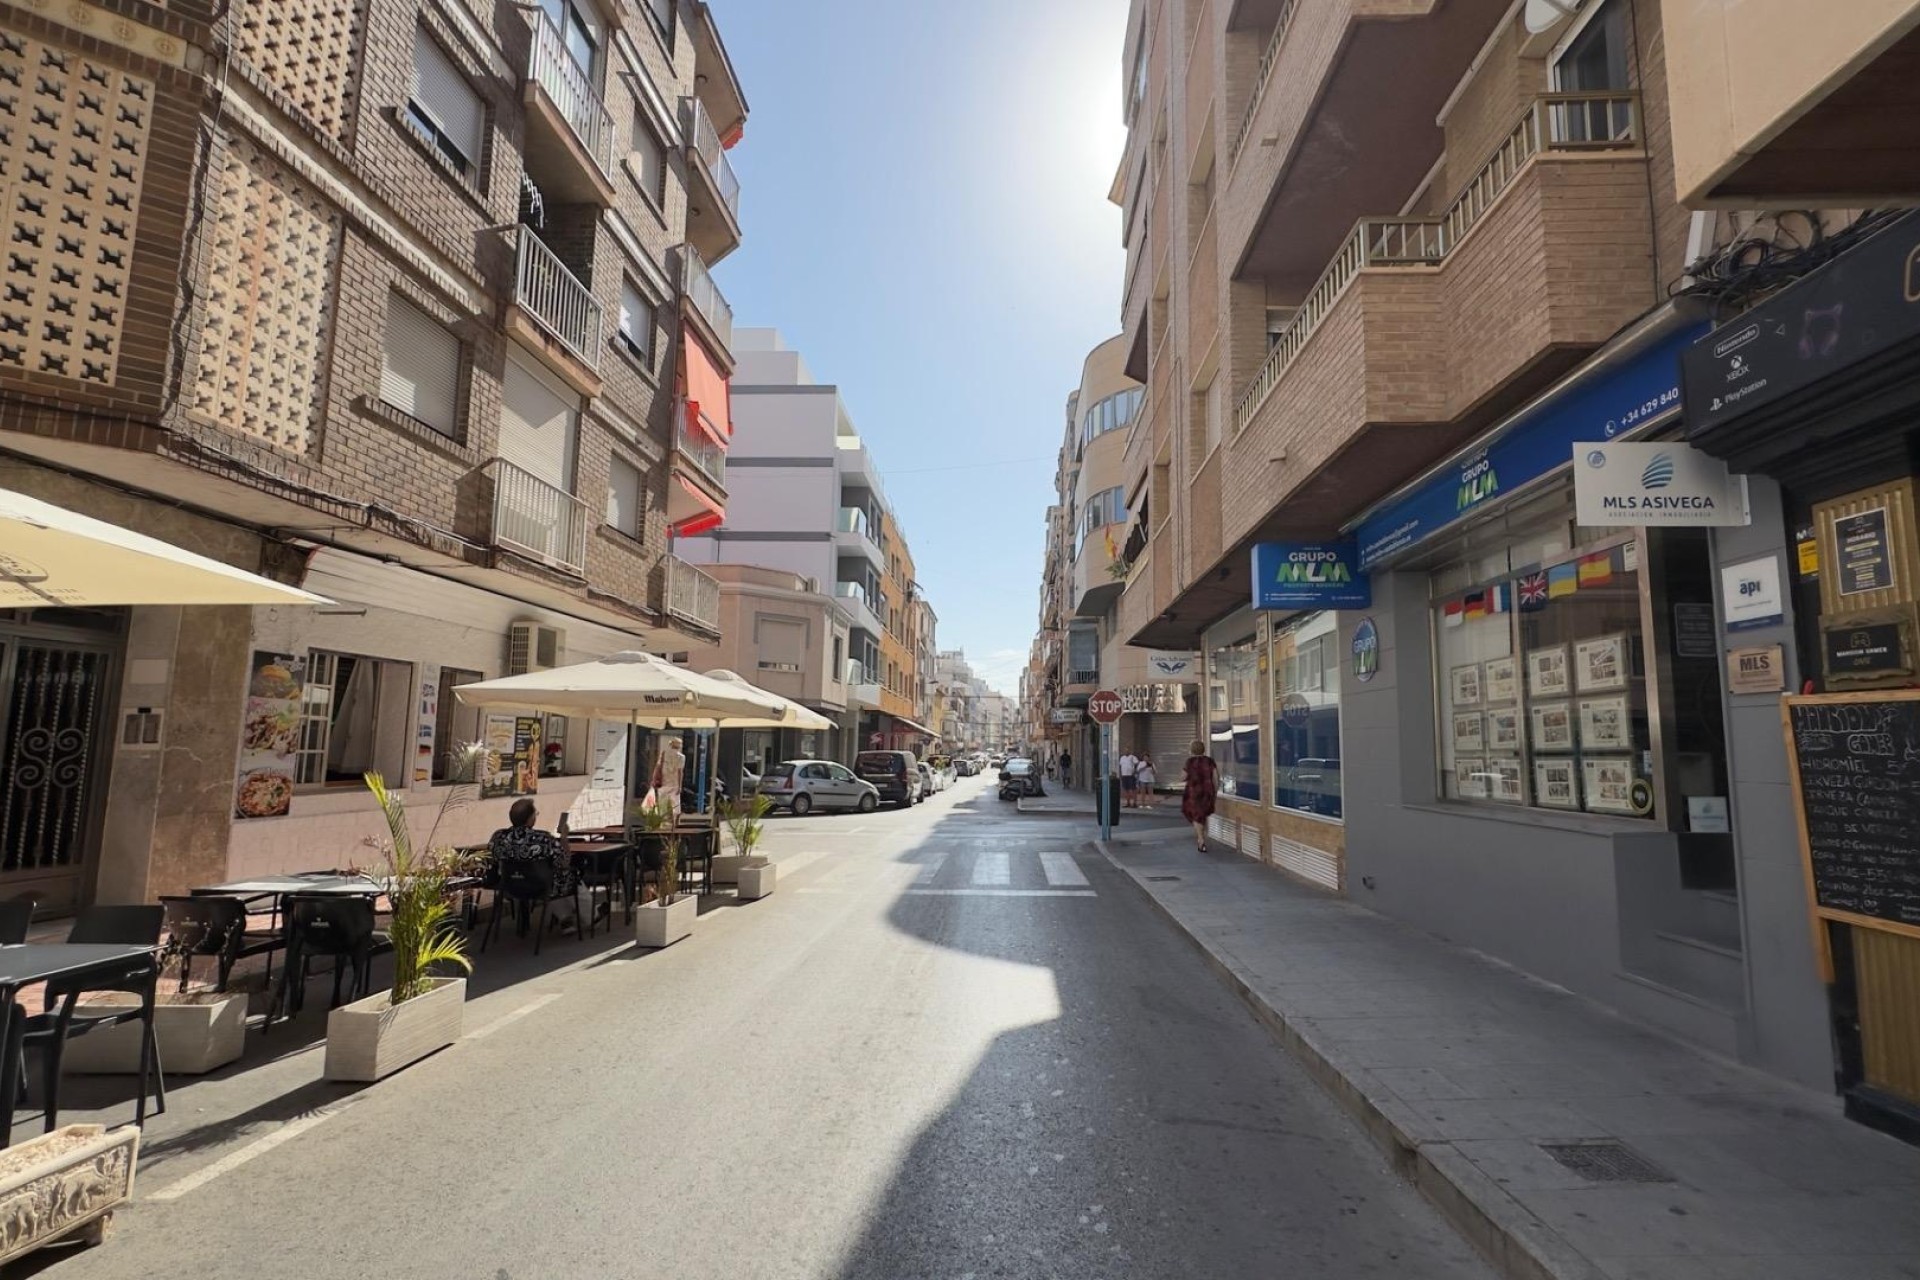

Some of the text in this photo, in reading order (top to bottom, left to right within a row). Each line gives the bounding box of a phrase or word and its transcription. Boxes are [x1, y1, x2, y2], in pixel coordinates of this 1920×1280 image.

[1716, 328, 1757, 355] Nintendo
[1726, 363, 1749, 382] XBOX
[1724, 378, 1767, 404] PlayStation
[1620, 387, 1679, 426] +34 629 840
[1461, 459, 1490, 483] GRUPO
[1456, 468, 1500, 513] MLM
[1603, 496, 1715, 509] MLS ASIVEGA
[1288, 551, 1337, 562] GRUPO
[1275, 562, 1352, 582] MLM
[1739, 580, 1761, 597] api
[1740, 655, 1770, 672] MLS
[643, 694, 680, 704] Mahou
[1091, 699, 1122, 713] STOP
